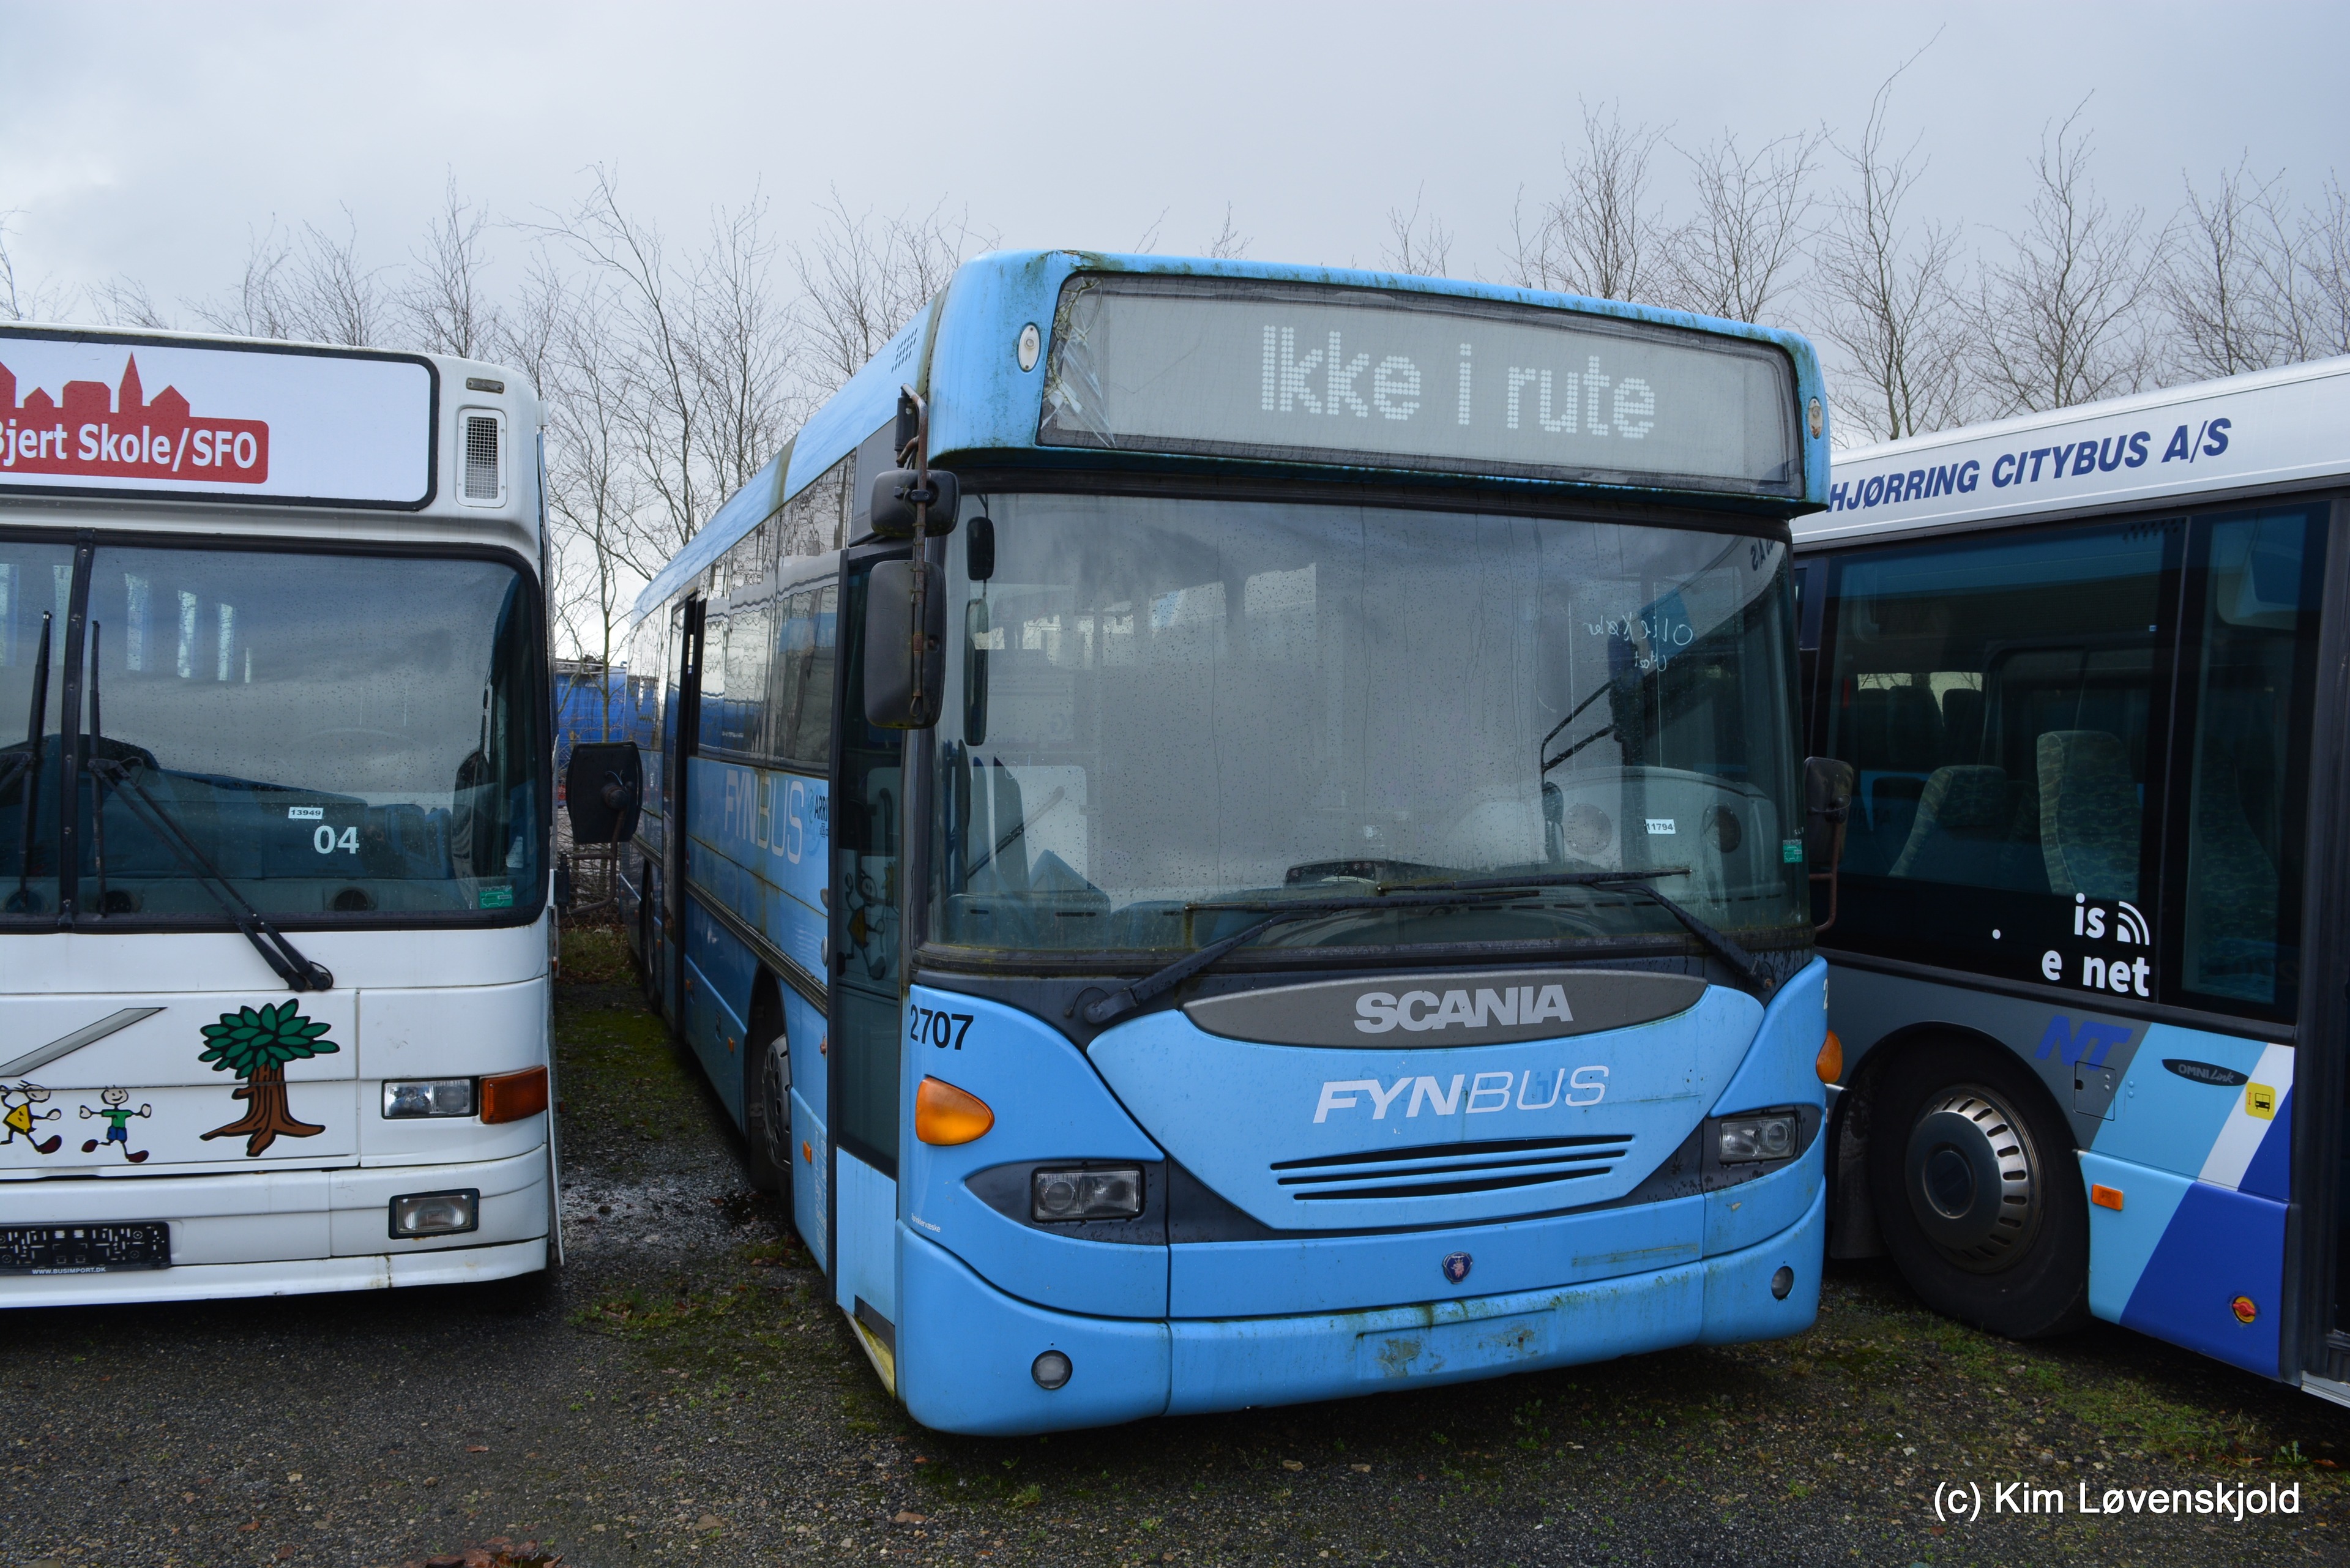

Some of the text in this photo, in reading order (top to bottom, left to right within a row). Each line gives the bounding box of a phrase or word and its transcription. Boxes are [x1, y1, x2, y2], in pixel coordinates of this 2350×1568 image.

[1261, 325, 1655, 439] Ikke i rute
[0, 419, 257, 472] jert Skole/SFO
[1826, 418, 2231, 513] HJØRRING CITYBUS A/S
[724, 769, 805, 865] FYNBUS
[815, 794, 829, 821] ARRI
[313, 825, 360, 854] 04
[2074, 892, 2105, 939] is
[2042, 950, 2150, 996] e net
[910, 1004, 974, 1050] 2707
[1354, 985, 1573, 1034] SCANIA
[2034, 1014, 2134, 1072] NT
[1313, 1065, 1610, 1124] FYNBUS
[32, 1266, 106, 1275] WWW.BUSIMPORT.DK
